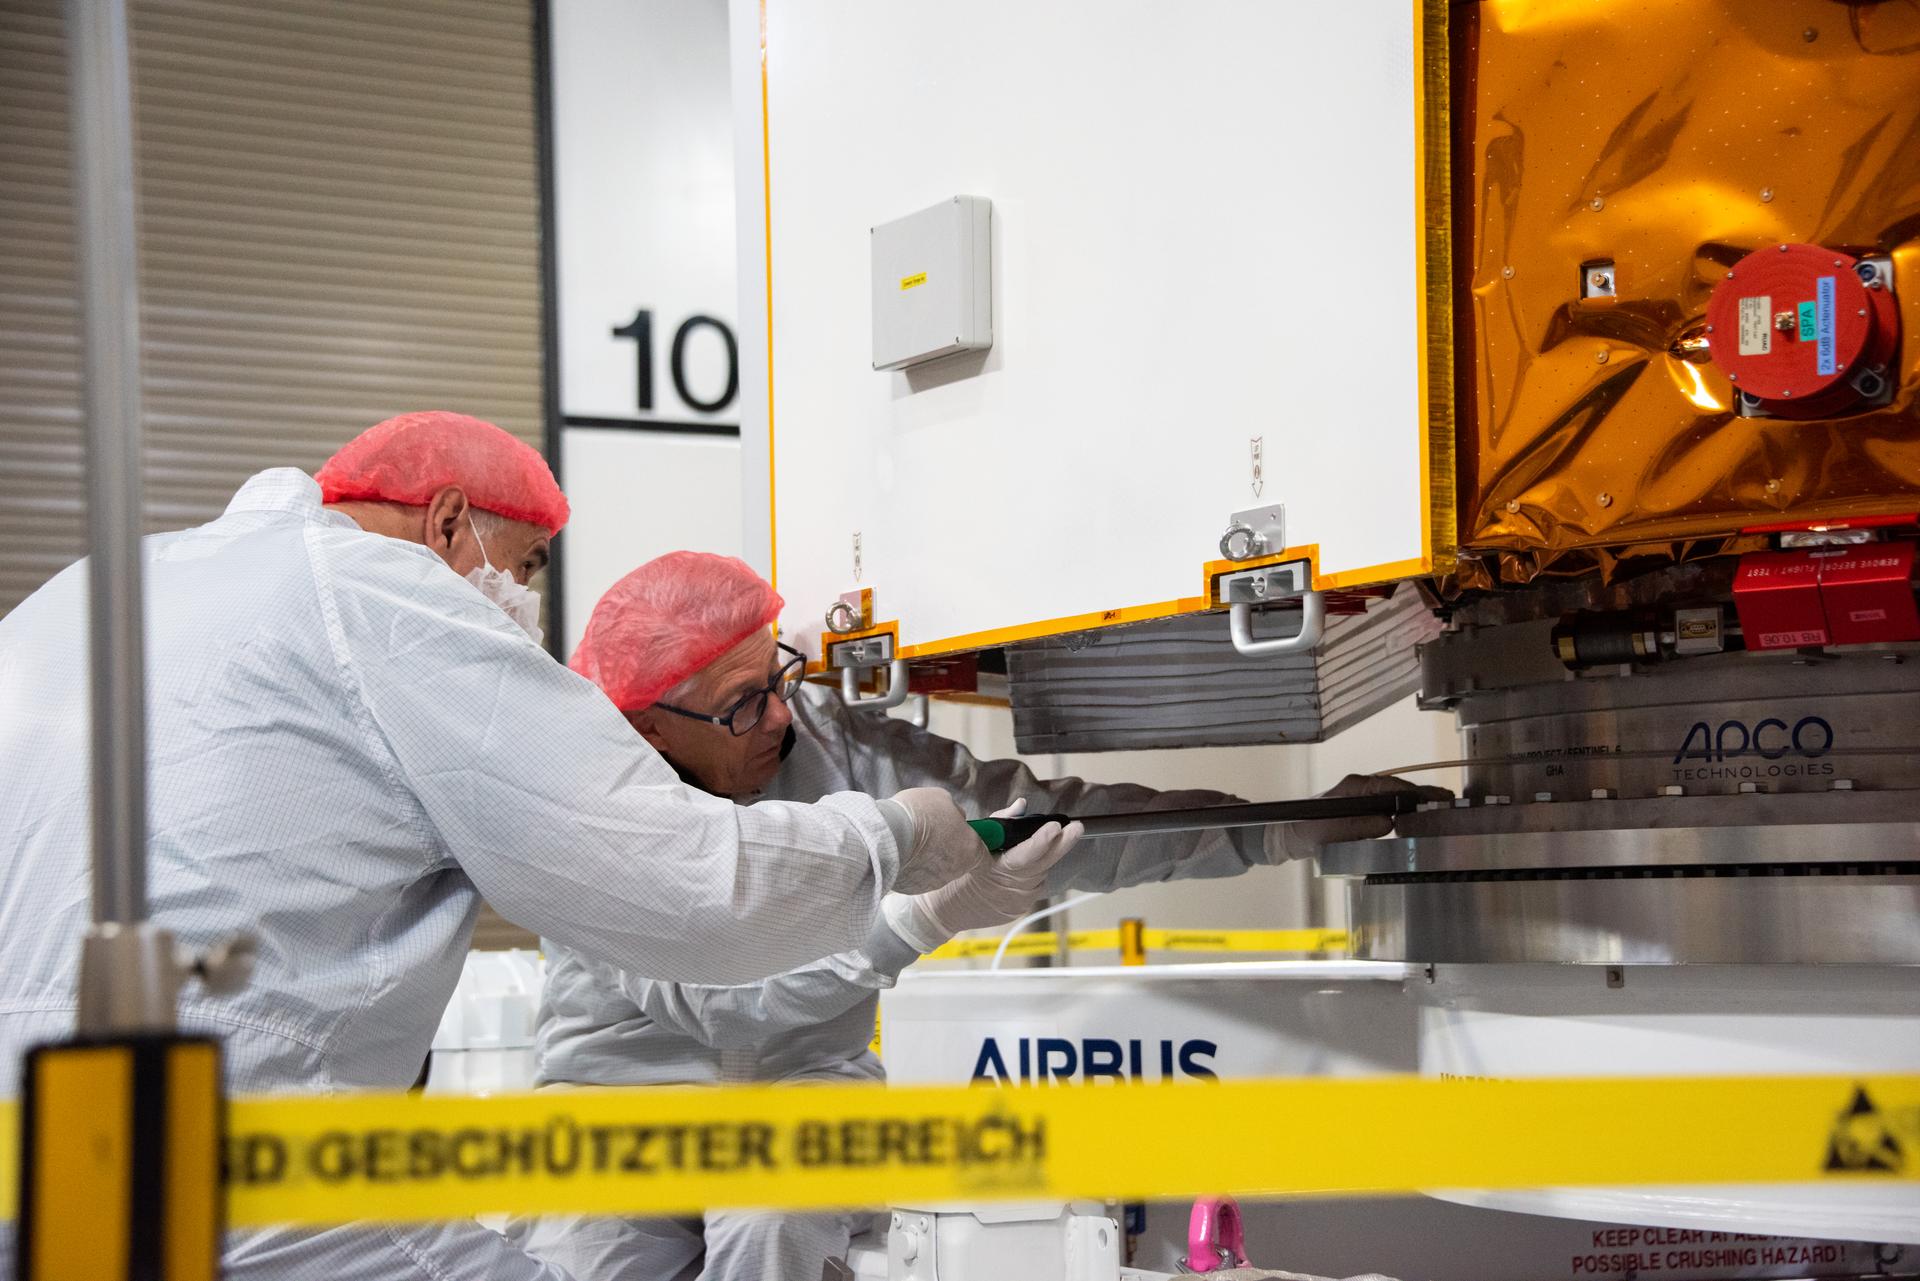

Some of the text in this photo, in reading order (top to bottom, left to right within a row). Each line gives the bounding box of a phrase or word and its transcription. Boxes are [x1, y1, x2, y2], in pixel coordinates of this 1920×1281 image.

[1801, 309, 1815, 337] SPA
[612, 309, 740, 413] 10
[1747, 568, 1770, 577] TEST
[1782, 564, 1816, 575] FLIGHT
[1860, 558, 1900, 567] REMOVE
[1672, 716, 1834, 764] APCO
[1673, 762, 1835, 781] TECHNOLOGIES
[969, 1037, 1220, 1087] AIRBUS
[310, 1114, 778, 1182] GESCHÜTZTER
[794, 1115, 1046, 1170] BEREICH
[1592, 1229, 1639, 1248] KEEP
[1572, 1252, 1661, 1274] POSSIBLE
[1666, 1247, 1757, 1270] CRUSHING
[1762, 1245, 1836, 1265] HAZARD
